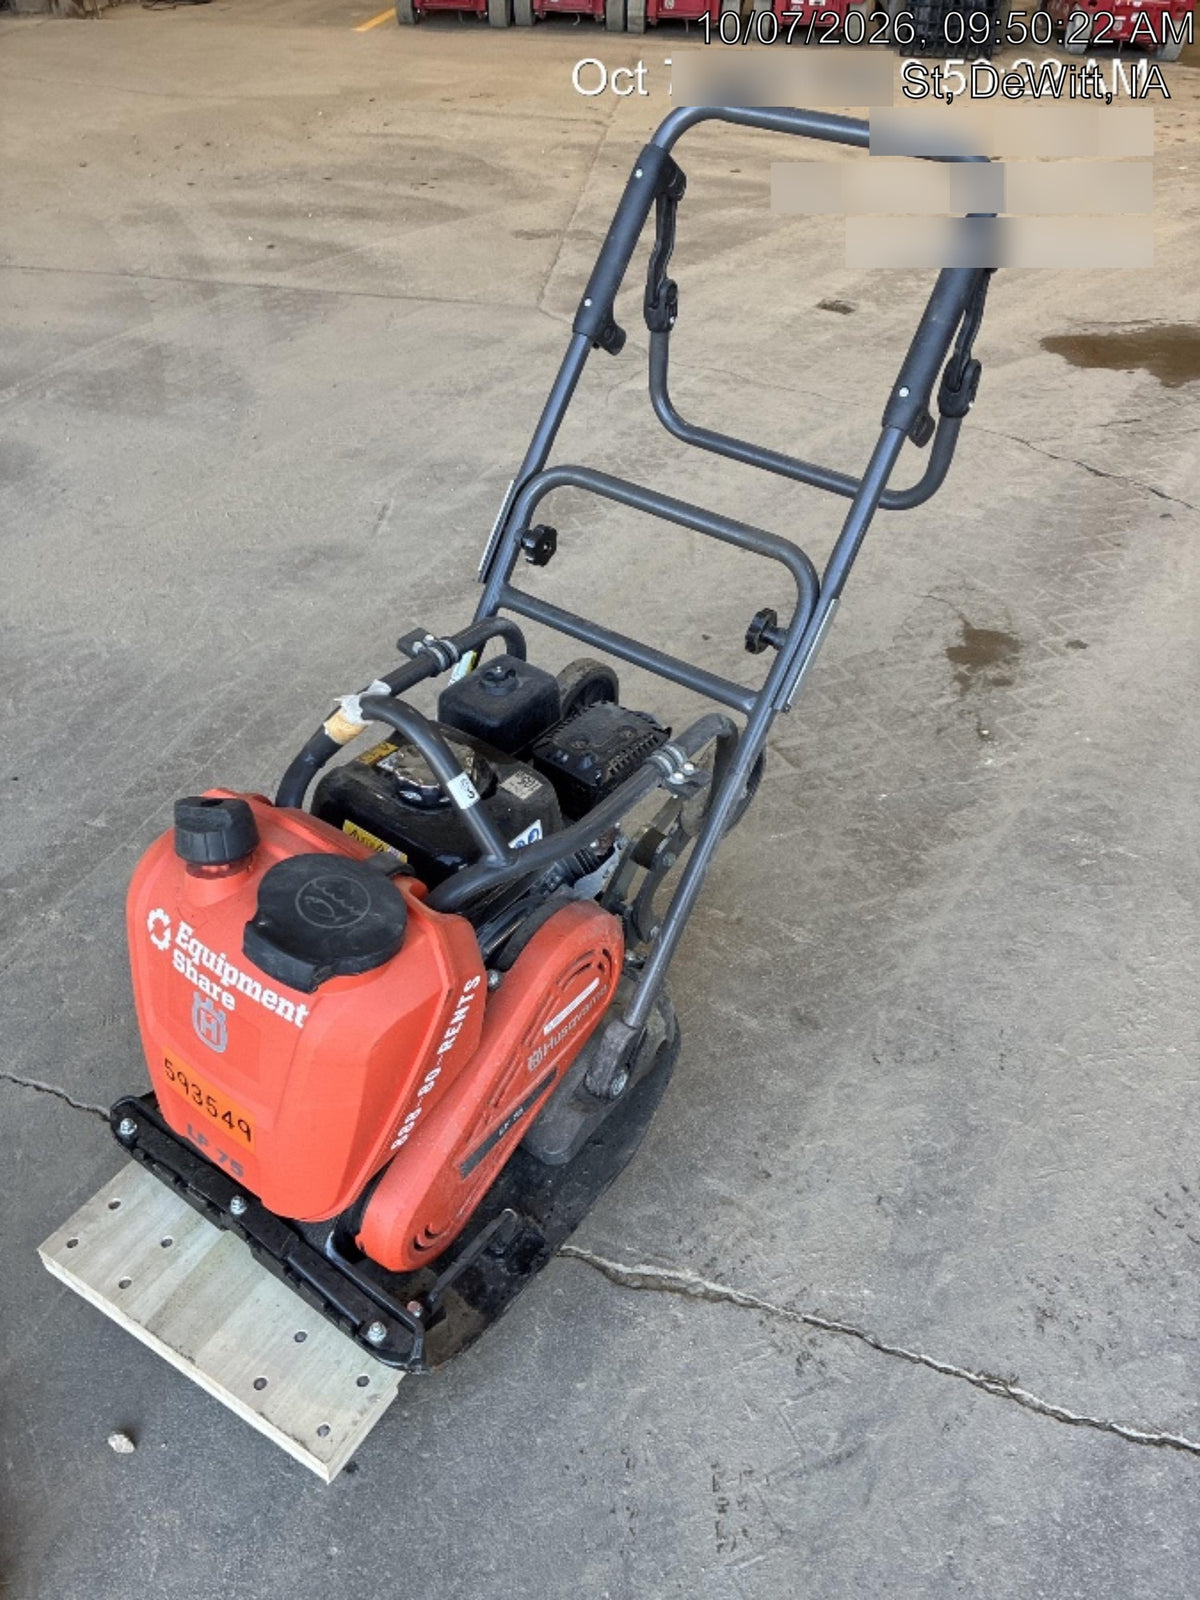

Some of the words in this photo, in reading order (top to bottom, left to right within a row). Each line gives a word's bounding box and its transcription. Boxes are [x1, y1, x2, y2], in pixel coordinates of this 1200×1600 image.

[172, 948, 236, 1012] Share
[174, 920, 310, 1029] Equipment
[164, 1057, 252, 1142] 593549
